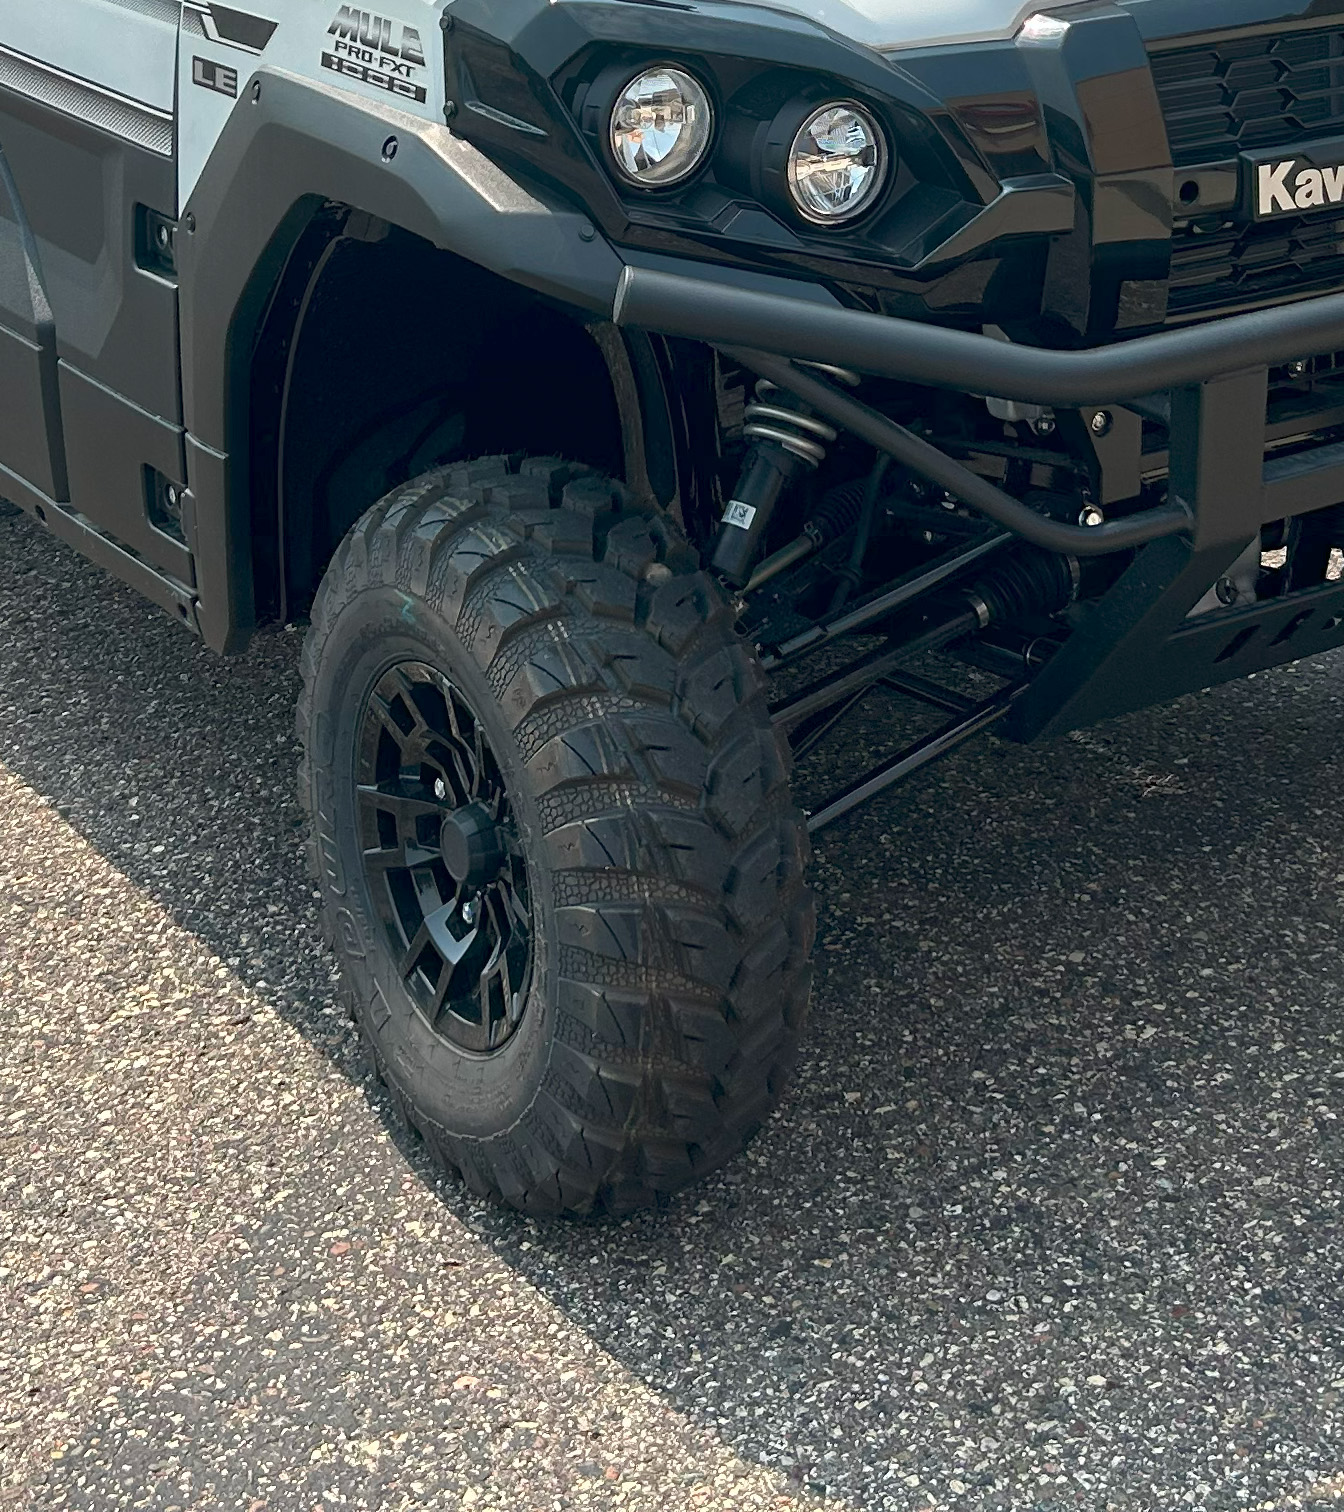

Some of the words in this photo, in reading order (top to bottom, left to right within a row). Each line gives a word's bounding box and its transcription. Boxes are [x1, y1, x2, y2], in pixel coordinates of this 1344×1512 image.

[327, 5, 426, 67] MULE
[193, 58, 238, 96] LE
[328, 55, 418, 100] 1000
